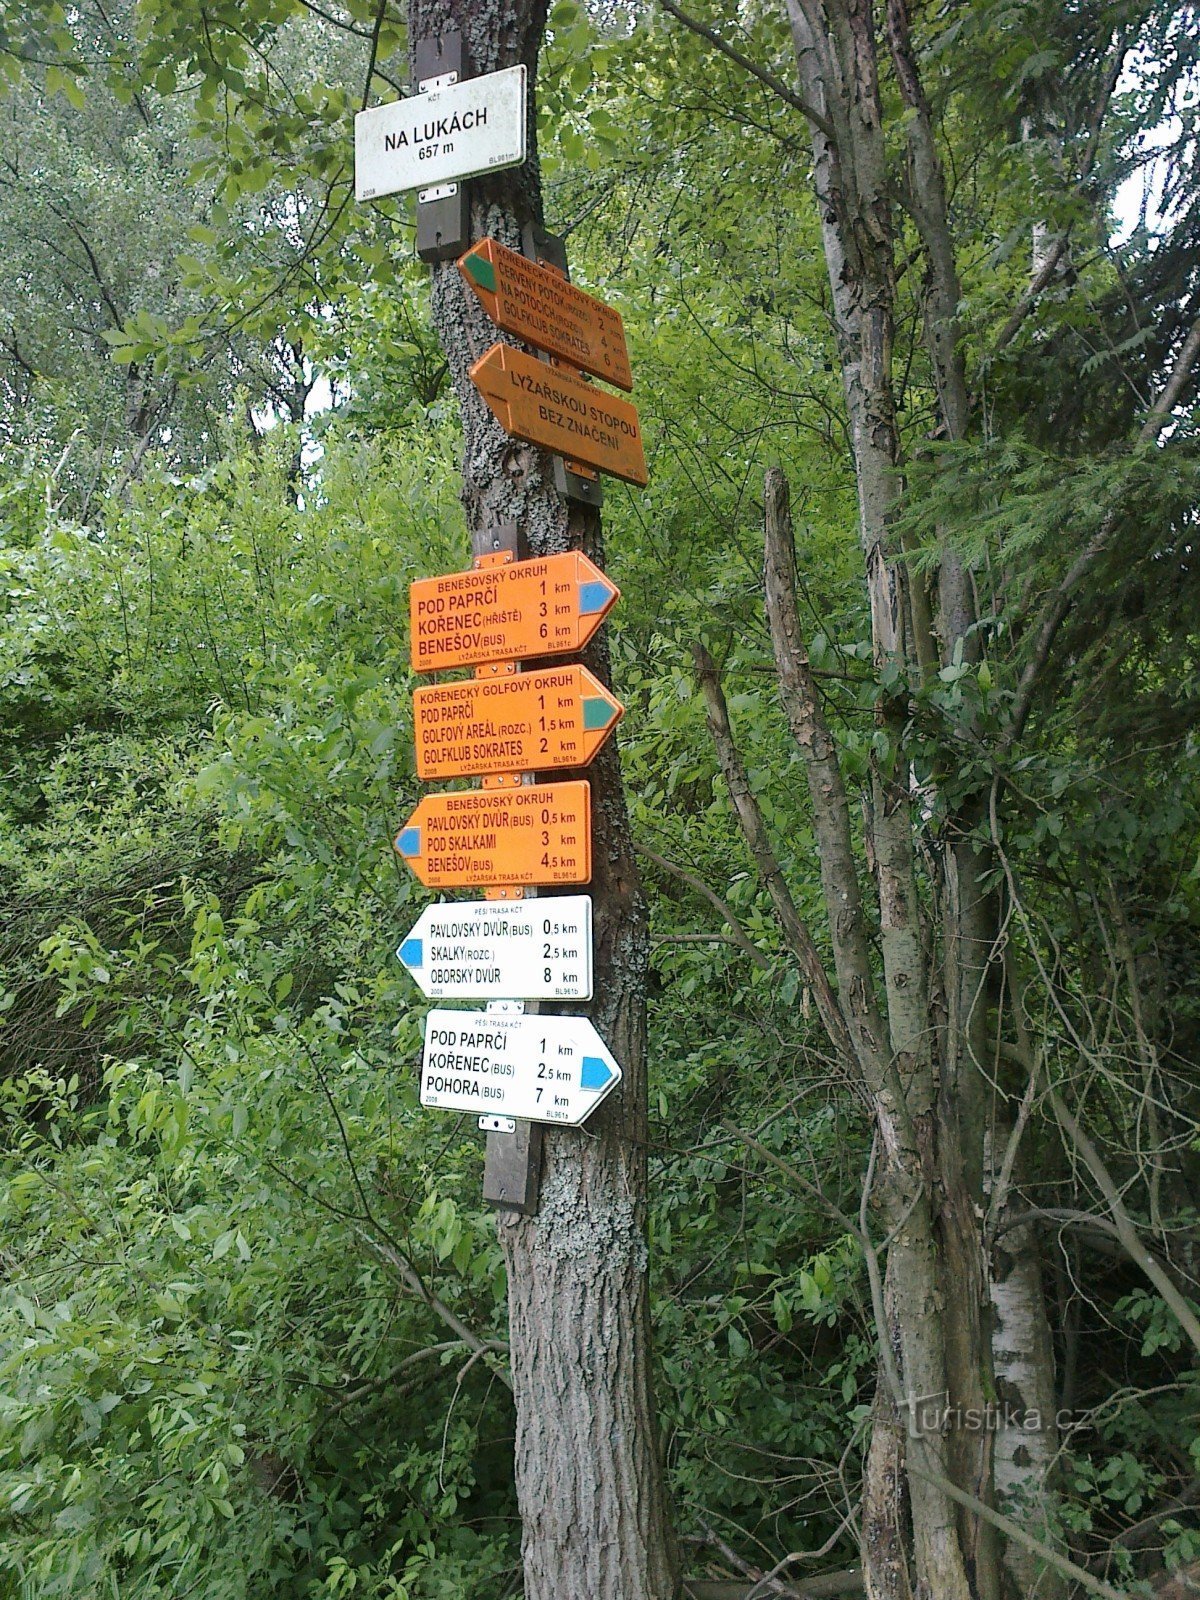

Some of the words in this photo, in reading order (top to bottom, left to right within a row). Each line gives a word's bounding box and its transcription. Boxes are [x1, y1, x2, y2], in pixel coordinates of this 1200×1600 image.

[385, 131, 409, 152] NA
[414, 107, 487, 144] LUKÁCH
[418, 144, 439, 160] 657
[443, 142, 454, 154] m
[500, 280, 513, 300] NA
[601, 336, 608, 349] 4
[598, 317, 605, 332] 2
[503, 301, 548, 334] GOLFKLUB
[549, 324, 591, 356] SOKRATES
[603, 353, 611, 368] 6
[510, 370, 587, 417] LYŽAŘSKOU
[589, 406, 637, 438] STOPOU
[538, 405, 565, 429] BEZ
[566, 416, 620, 451] ZNAČENÍ
[438, 570, 507, 594] BENEŠOVSKÝ
[509, 564, 548, 581] OKRUH
[418, 598, 445, 616] POD
[449, 585, 498, 611] PAPRČÍ
[539, 580, 546, 596] 1
[555, 582, 571, 594] km
[539, 602, 548, 617] 3
[555, 604, 571, 616] km
[539, 623, 548, 639] 6
[555, 626, 571, 637] km
[491, 647, 514, 658] TRASA
[513, 644, 528, 654] KČT
[482, 679, 532, 697] GOLFOVÝ
[534, 674, 573, 690] OKRUH
[420, 707, 440, 725] POD
[441, 699, 475, 723] PAPRČÍ
[538, 694, 545, 711] 1
[557, 697, 574, 709] km
[422, 720, 465, 745] GOLFOVÝ
[466, 718, 497, 740] AREÁL
[498, 722, 532, 738] (ROZC.)
[538, 715, 557, 734] 1,5
[558, 718, 575, 730] km
[423, 744, 471, 765] GOLFKLUB
[473, 740, 523, 761] SOKRATES
[539, 737, 549, 753] 2
[560, 739, 577, 752] km
[493, 759, 516, 769] TRASA
[515, 757, 530, 767] KČT
[446, 793, 514, 811] BENEŠOVSKÝ
[516, 792, 554, 805] OKRUH
[427, 810, 481, 832] PAVLOVSKÝ
[541, 808, 558, 826] 0,5
[560, 812, 577, 824] km
[427, 836, 446, 852] POD
[449, 833, 498, 851] SKALKAMI
[541, 830, 550, 847] 3
[560, 834, 577, 845] km
[540, 852, 558, 868] 4,5
[560, 855, 577, 868] km
[498, 872, 520, 881] TRASA
[520, 871, 534, 880] KČT
[488, 907, 510, 915] TRASA
[510, 905, 524, 915] KČT
[430, 918, 482, 938] PAVLOVSKÝ
[542, 918, 560, 935] 0,5
[562, 923, 578, 934] km
[542, 943, 560, 960] 2,5
[562, 947, 578, 959] km
[431, 964, 474, 984] OBORSKÝ
[543, 967, 553, 984] 8
[562, 971, 578, 983] km
[488, 1020, 510, 1029] TRASA
[430, 1030, 457, 1047] POD
[459, 1031, 508, 1051] PAPRČÍ
[539, 1038, 547, 1054] 1
[558, 1045, 574, 1057] km
[537, 1062, 554, 1080] 2,5
[556, 1069, 572, 1082] km
[535, 1087, 544, 1104] 7
[554, 1094, 570, 1107] km
